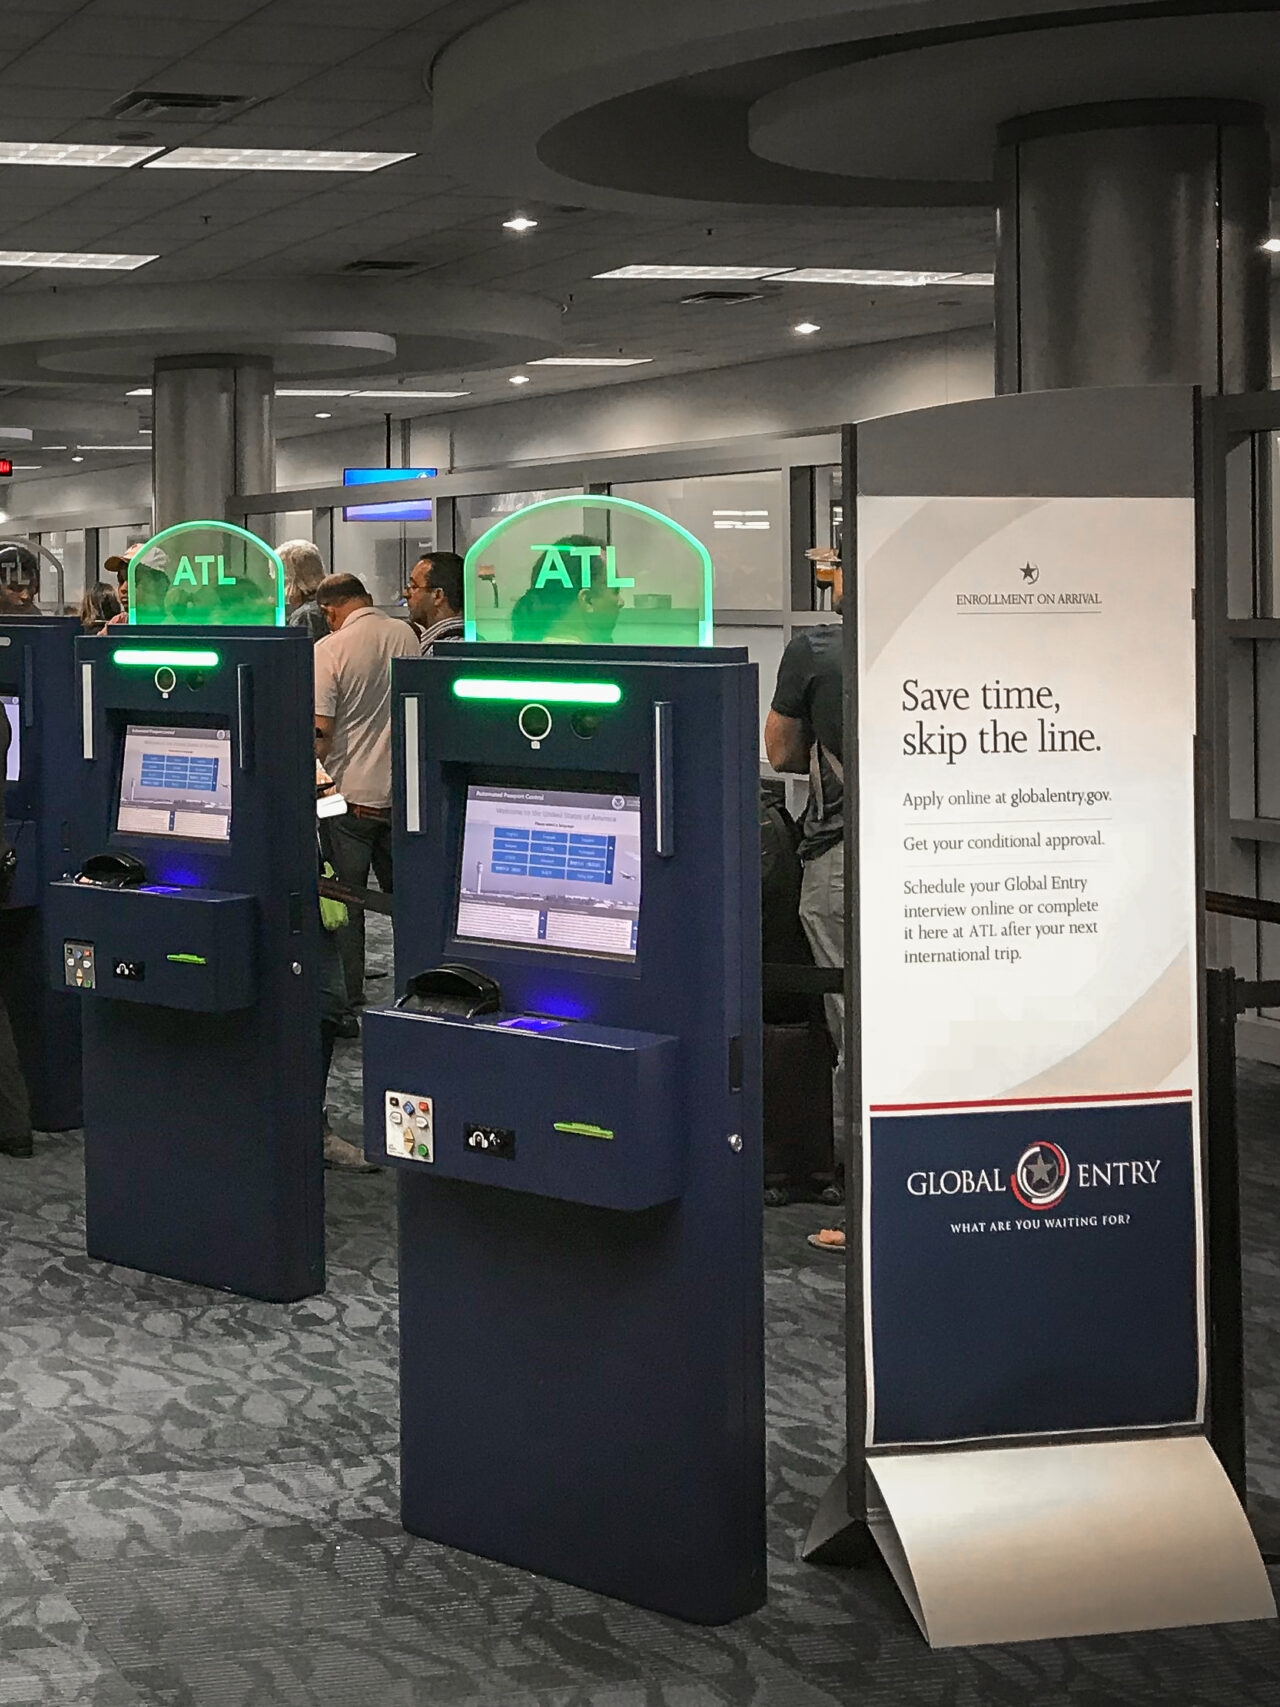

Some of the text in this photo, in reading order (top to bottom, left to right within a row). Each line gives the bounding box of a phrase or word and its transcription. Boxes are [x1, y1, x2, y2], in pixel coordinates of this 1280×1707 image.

[173, 555, 236, 586] ATL
[533, 545, 635, 588] ATL
[957, 593, 1102, 605] ENROLLMENT ON ARRIVAL
[903, 679, 1059, 713] Save time,
[903, 718, 1101, 765] skip the line.
[903, 788, 1111, 810] Apply online at globalentry.gov.
[904, 830, 1104, 854] Get your conditional approval.
[904, 875, 1087, 896] Schedule your Global Entry
[904, 897, 1098, 918] interview online or complete
[905, 921, 1098, 939] it here at ATL after your next
[905, 946, 1021, 964] international trip.
[907, 1160, 1160, 1195] GLOBAL ENTRY
[951, 1214, 1130, 1233] WHAT ARE YOU WAITING FOR?
